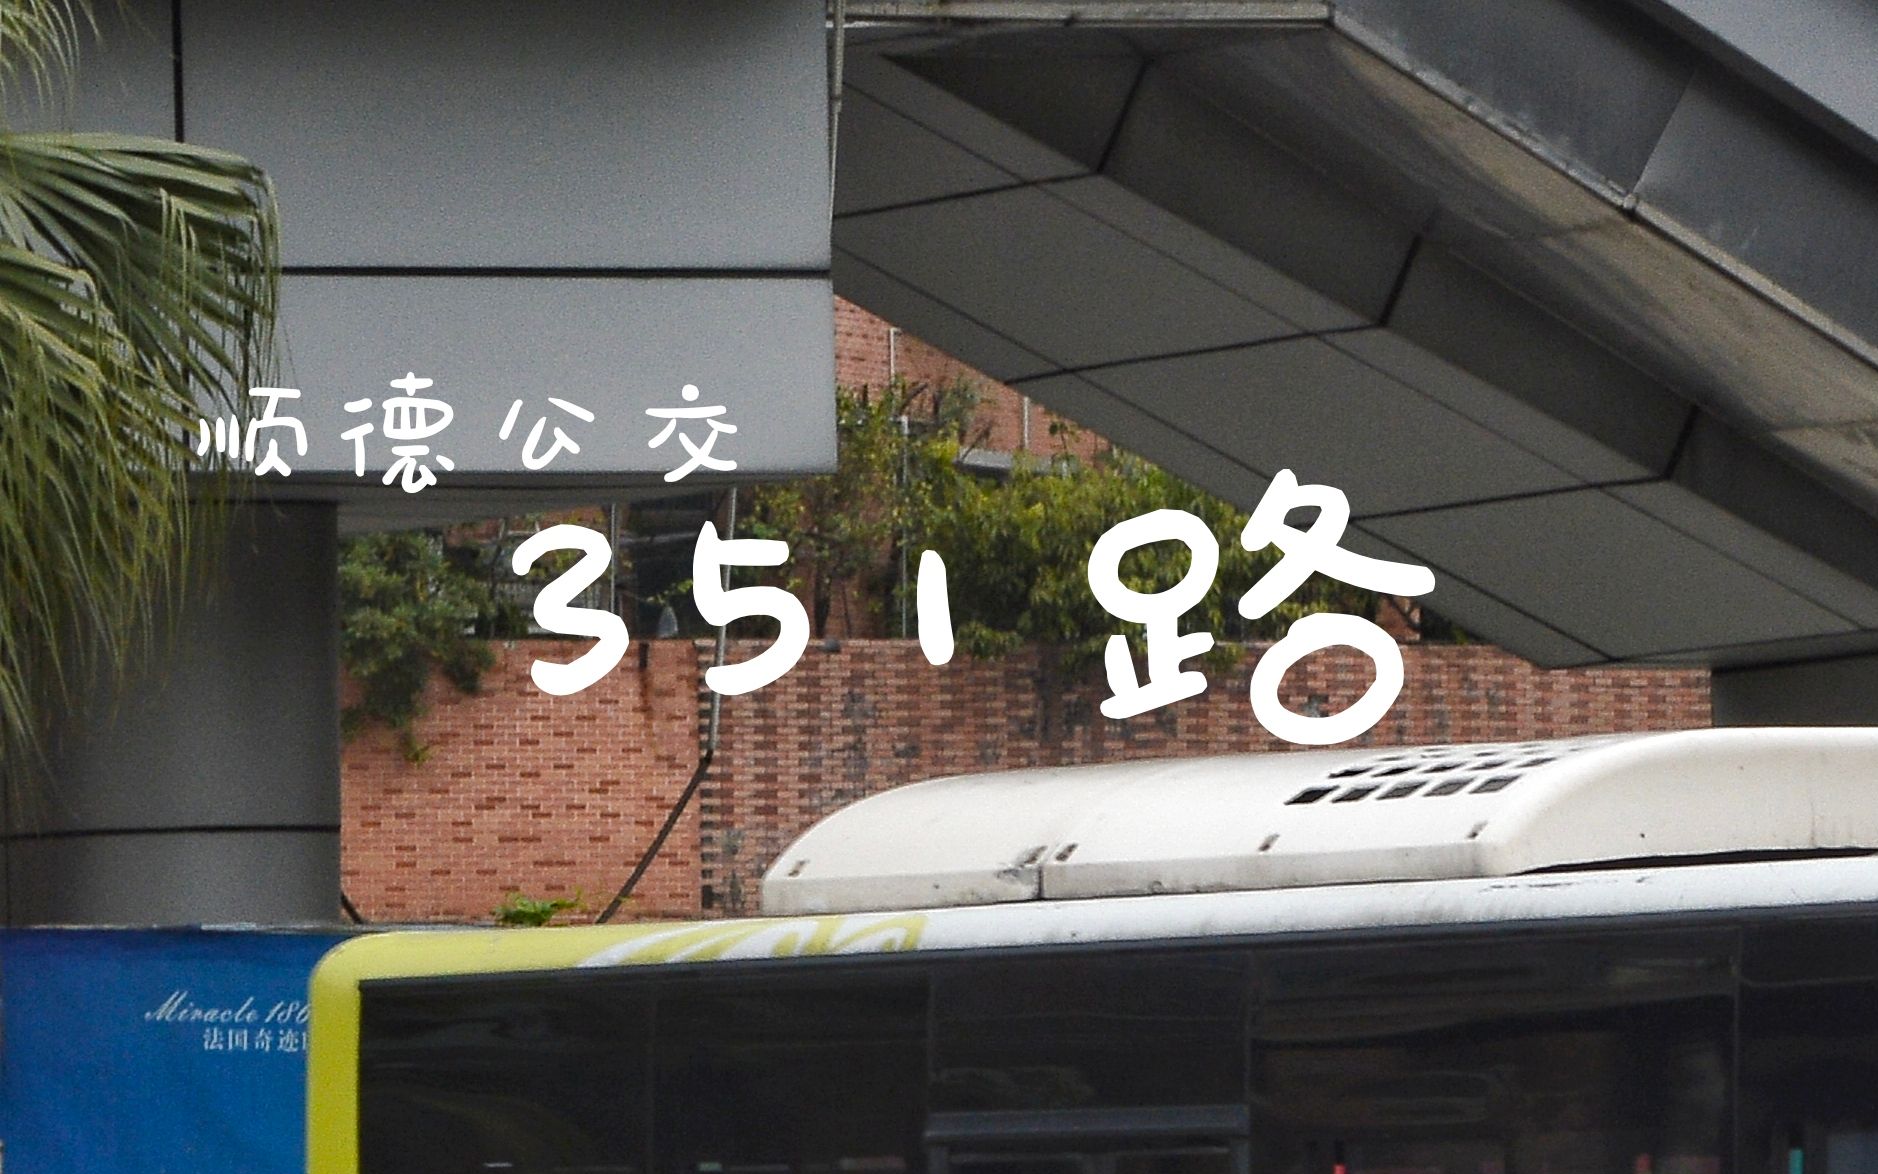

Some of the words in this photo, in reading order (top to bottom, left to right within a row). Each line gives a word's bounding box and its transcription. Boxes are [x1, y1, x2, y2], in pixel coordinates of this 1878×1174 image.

[144, 990, 258, 1022] Miracle
[203, 1026, 308, 1052] 法国奇迹
